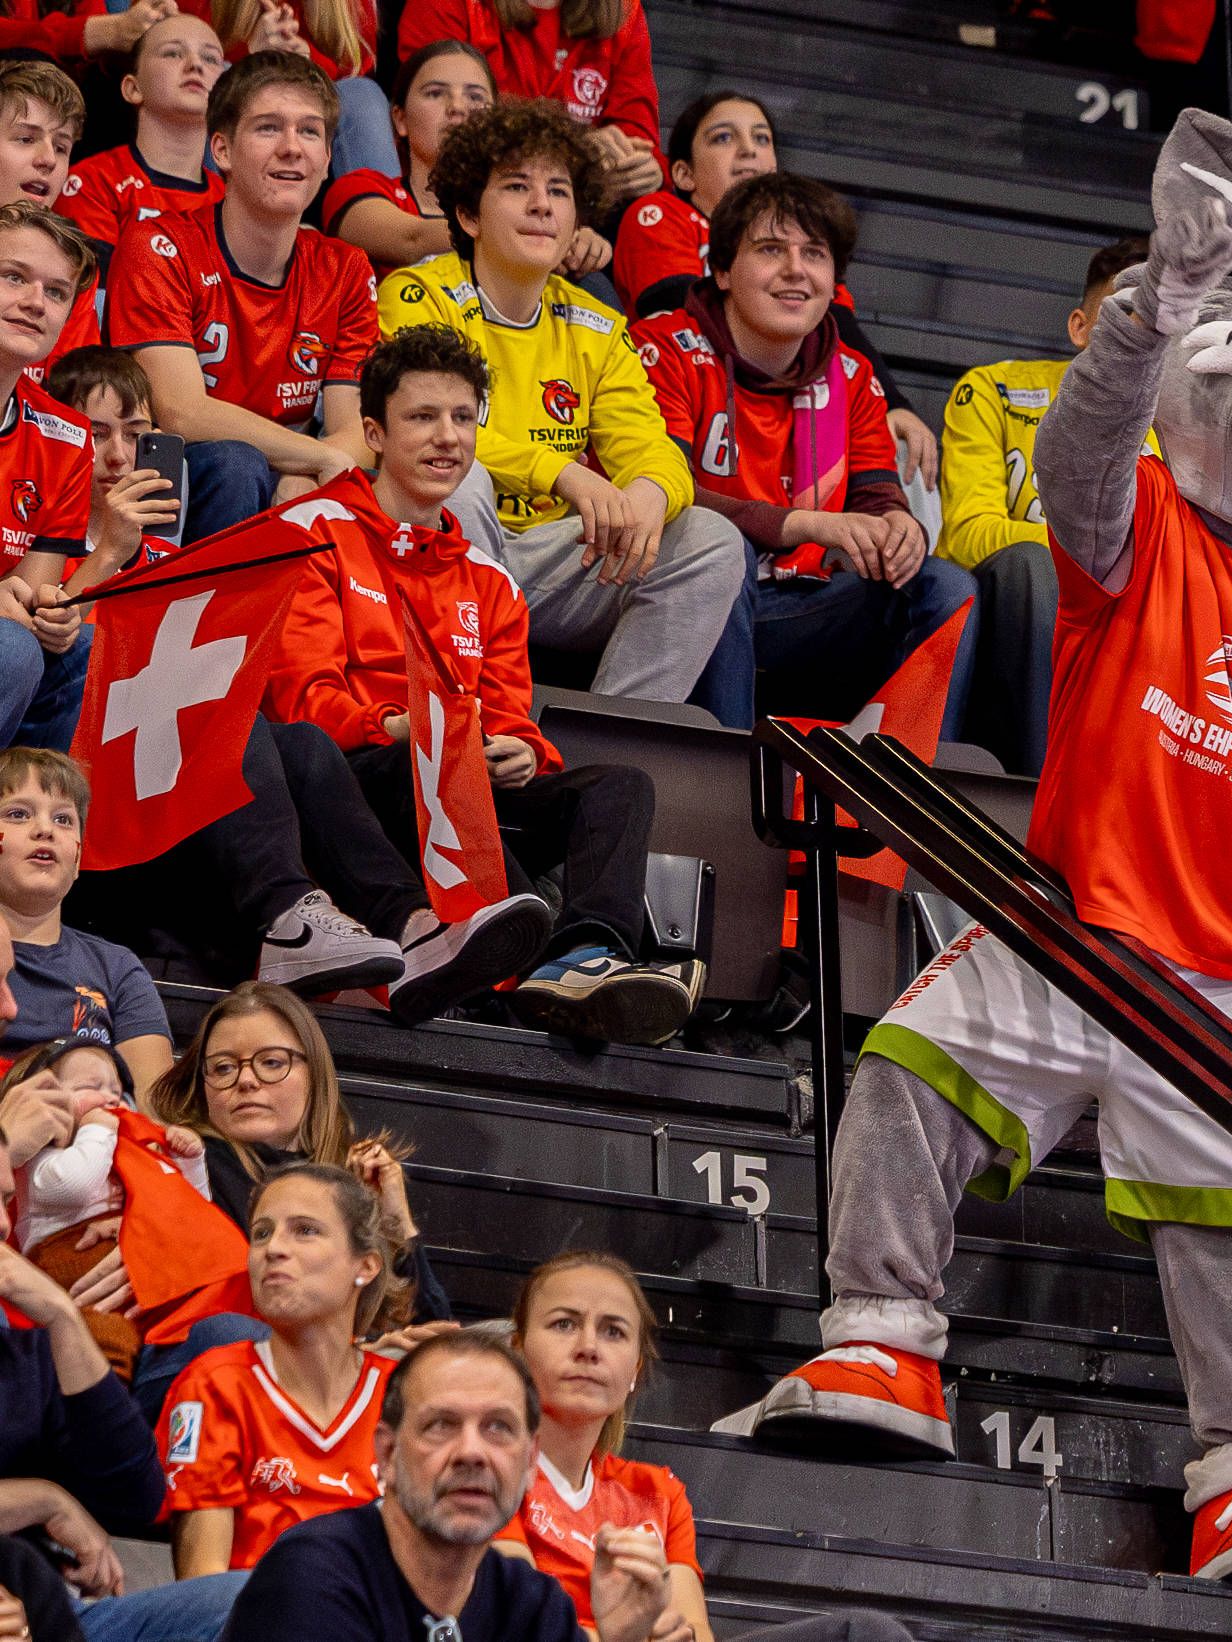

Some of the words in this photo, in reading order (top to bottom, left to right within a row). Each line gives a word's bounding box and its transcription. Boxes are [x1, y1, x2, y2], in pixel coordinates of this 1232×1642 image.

[1076, 82, 1138, 129] 21
[528, 428, 556, 442] TSV
[350, 575, 387, 605] Kempa
[1141, 685, 1206, 744] WOMEN'S
[1182, 748, 1226, 776] HUNGARY
[692, 1151, 770, 1215] 15
[980, 1411, 1063, 1474] 14
